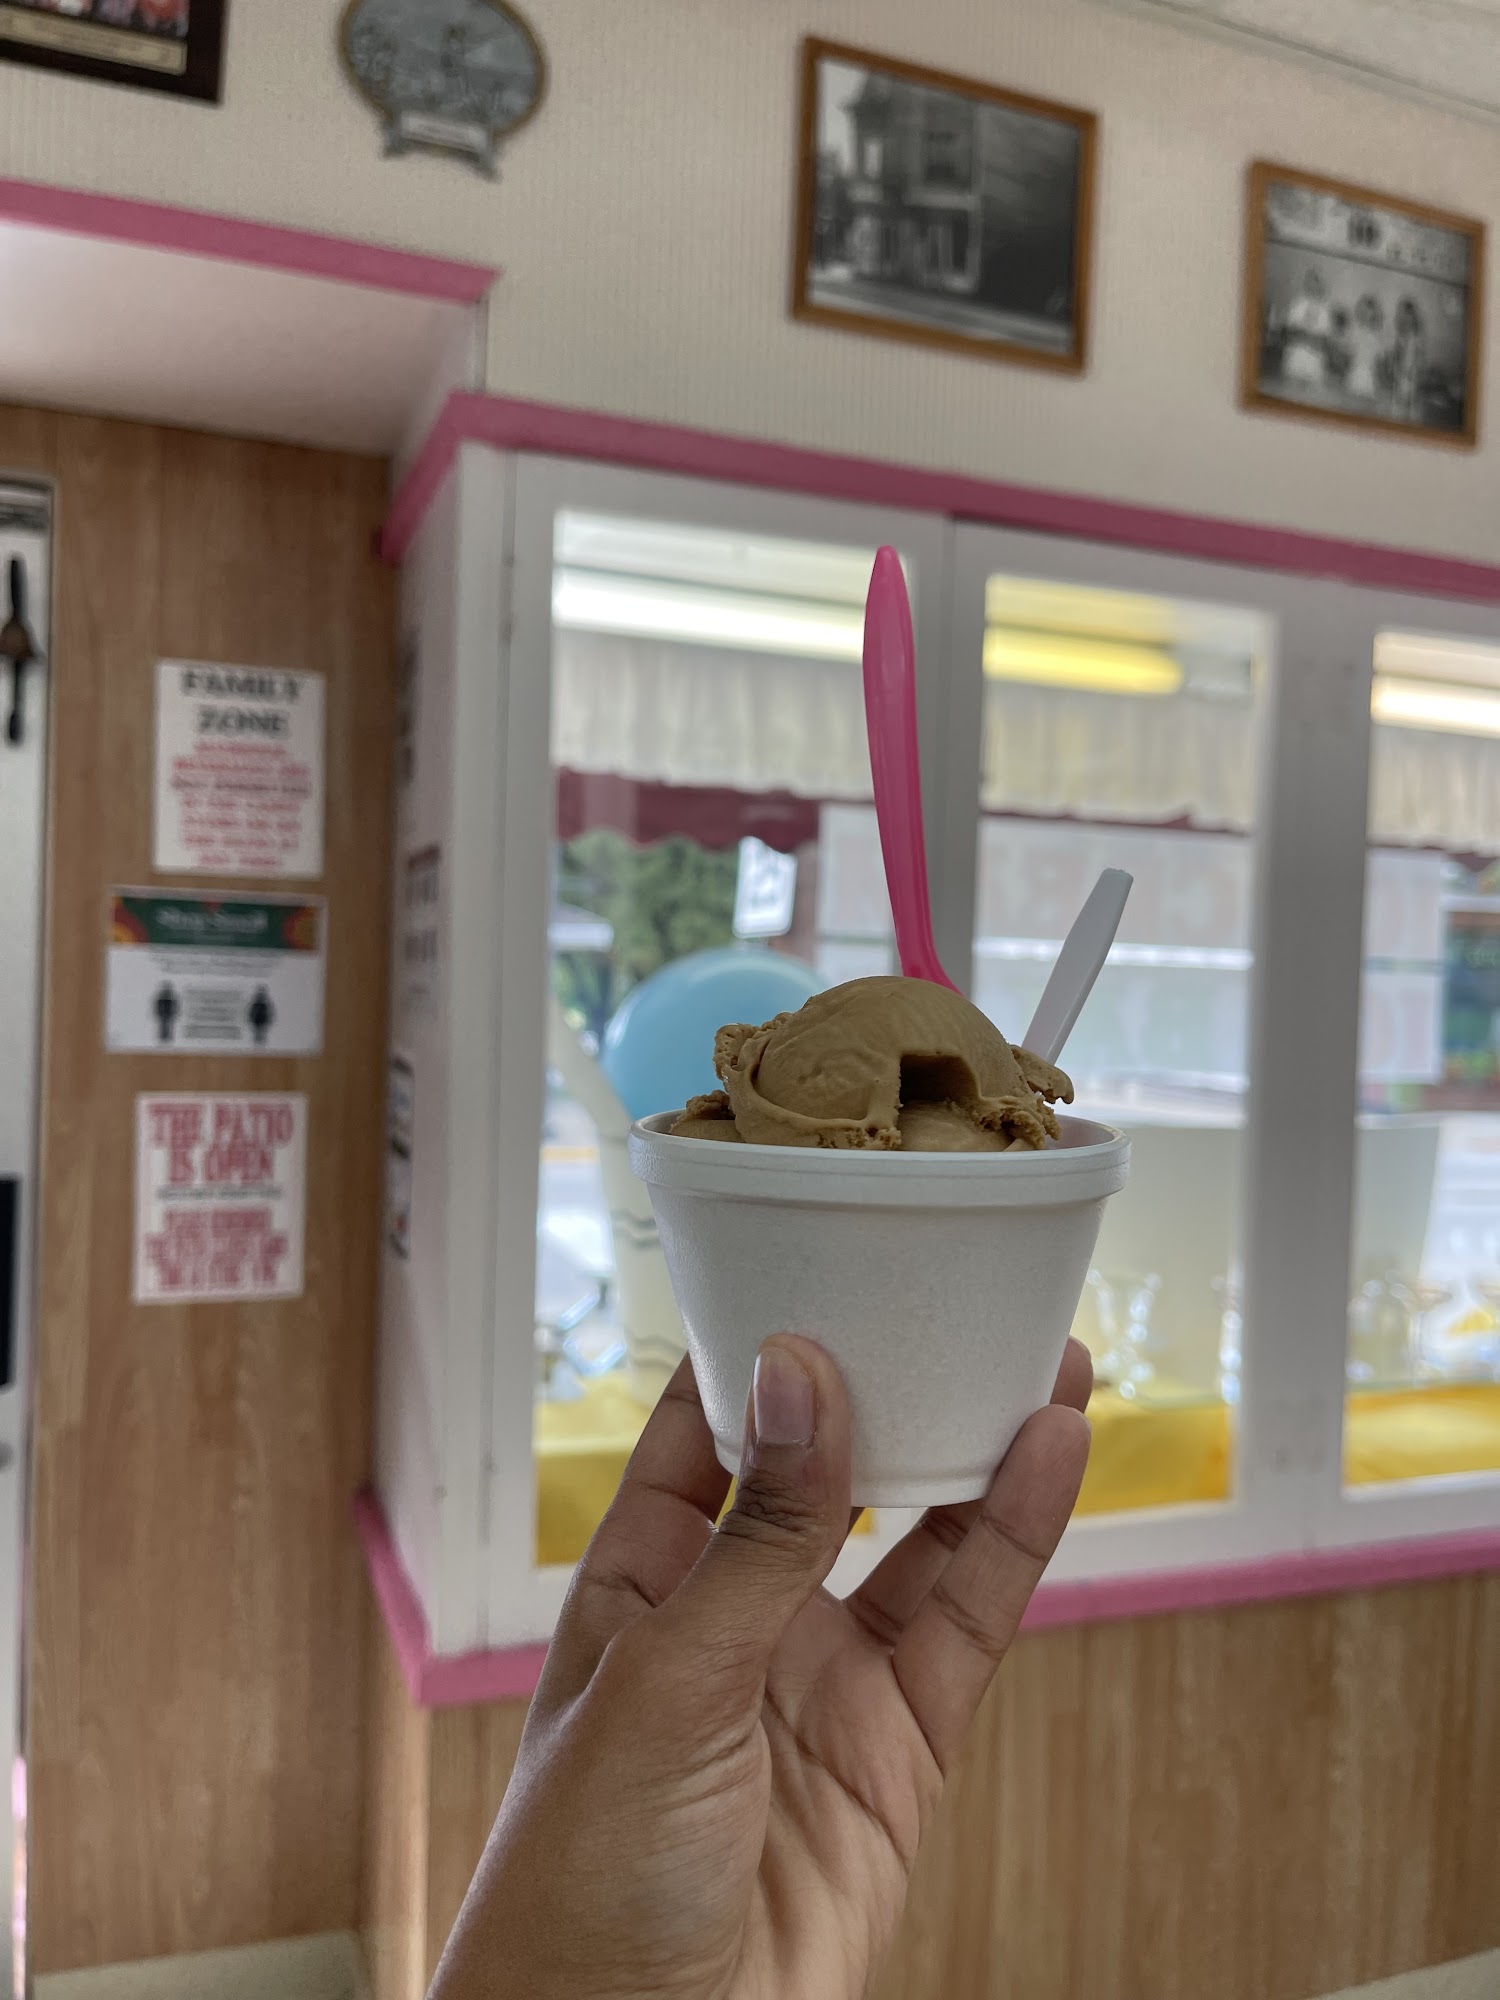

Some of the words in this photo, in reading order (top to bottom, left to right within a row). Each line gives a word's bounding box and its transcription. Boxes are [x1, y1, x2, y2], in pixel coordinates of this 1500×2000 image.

[180, 669, 302, 703] FAMILY
[198, 704, 289, 738] ZONE
[148, 1103, 203, 1147] THE
[212, 1103, 294, 1147] PATIO
[169, 1145, 195, 1184] IS
[204, 1145, 273, 1185] OPEN
